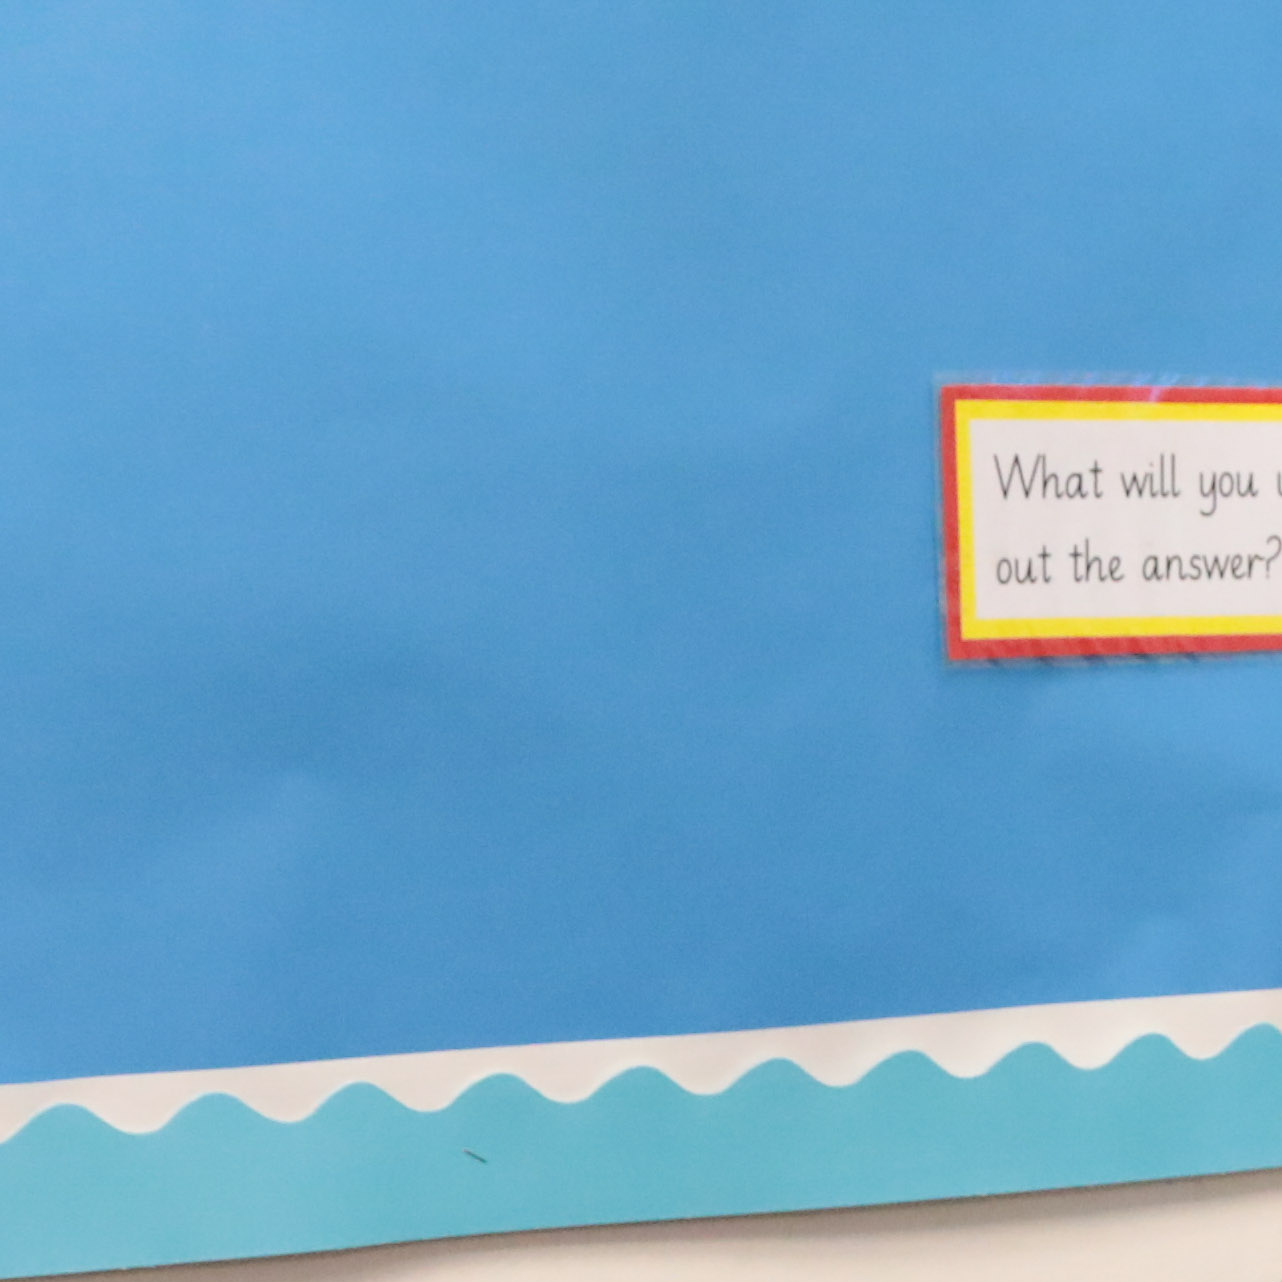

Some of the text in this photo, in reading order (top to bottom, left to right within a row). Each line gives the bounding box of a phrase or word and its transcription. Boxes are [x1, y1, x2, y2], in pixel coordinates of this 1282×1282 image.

[993, 453, 1104, 500] What
[1120, 452, 1181, 499] will
[1199, 475, 1259, 517] you
[995, 543, 1053, 585] out
[1068, 538, 1125, 584] the
